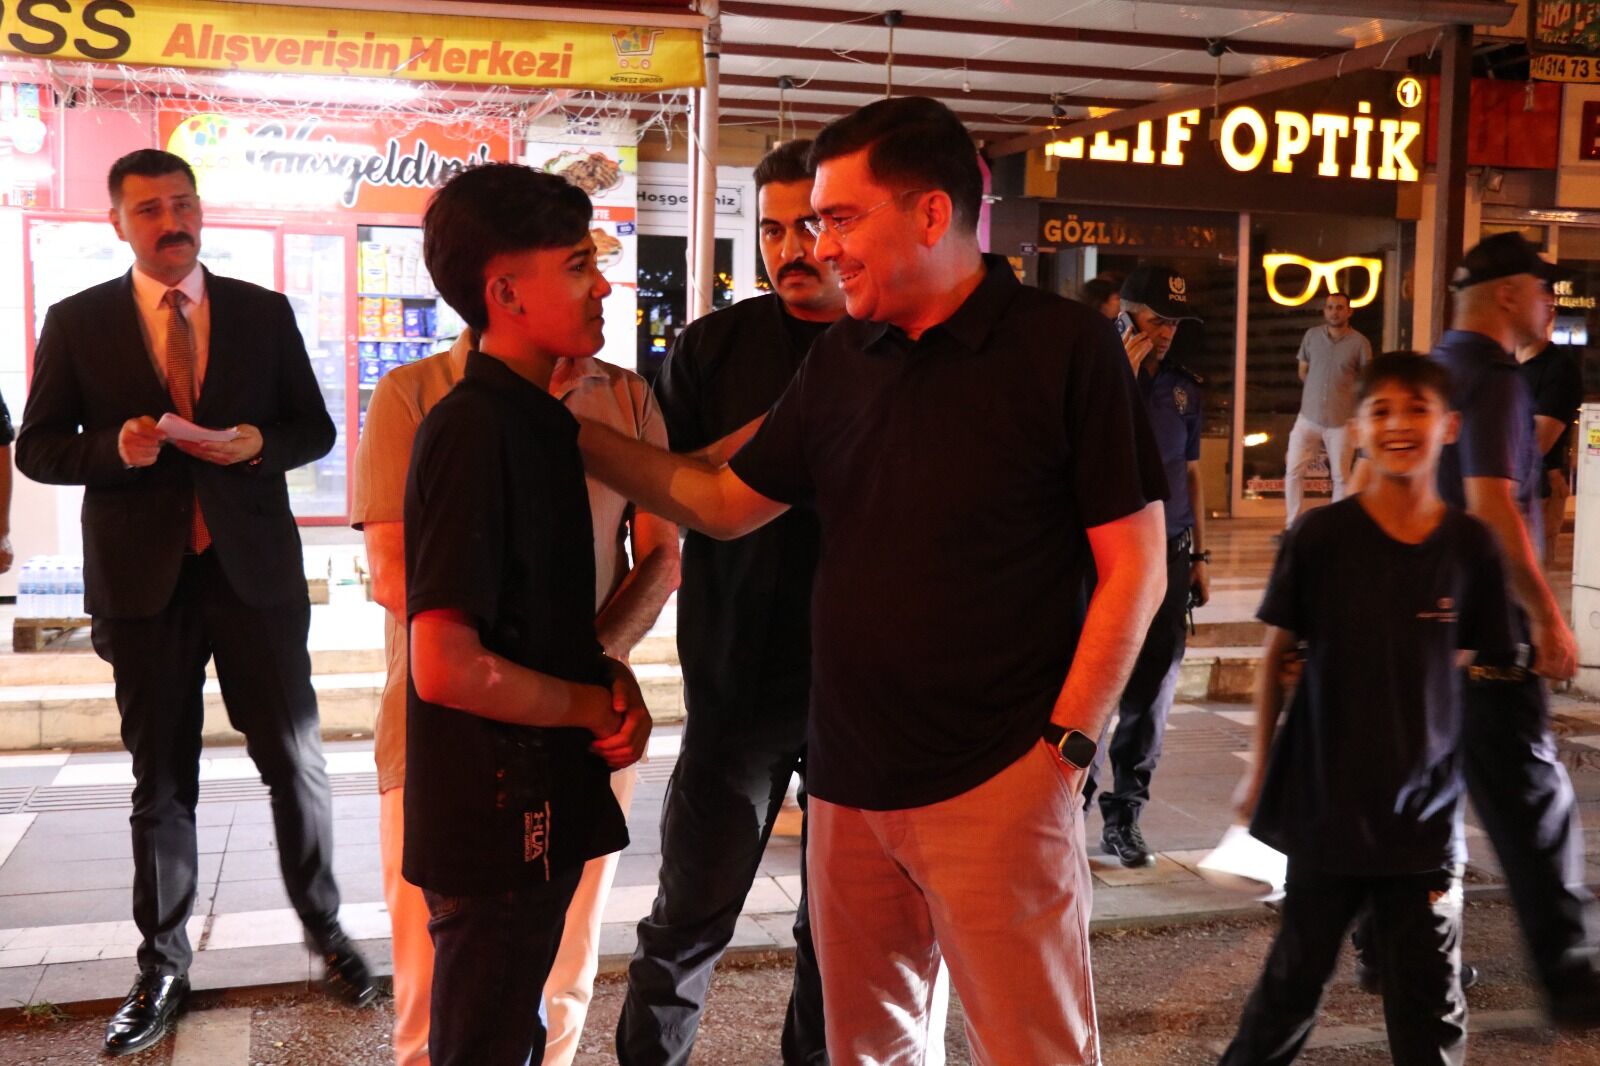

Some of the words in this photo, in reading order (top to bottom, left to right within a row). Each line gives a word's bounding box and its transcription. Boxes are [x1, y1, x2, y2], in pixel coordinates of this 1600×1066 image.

[0, 0, 136, 59] SS
[161, 23, 401, 75] Alışverişin
[407, 37, 574, 79] Merkezi
[1571, 60, 1589, 78] 73
[1220, 101, 1421, 182] OPTİK
